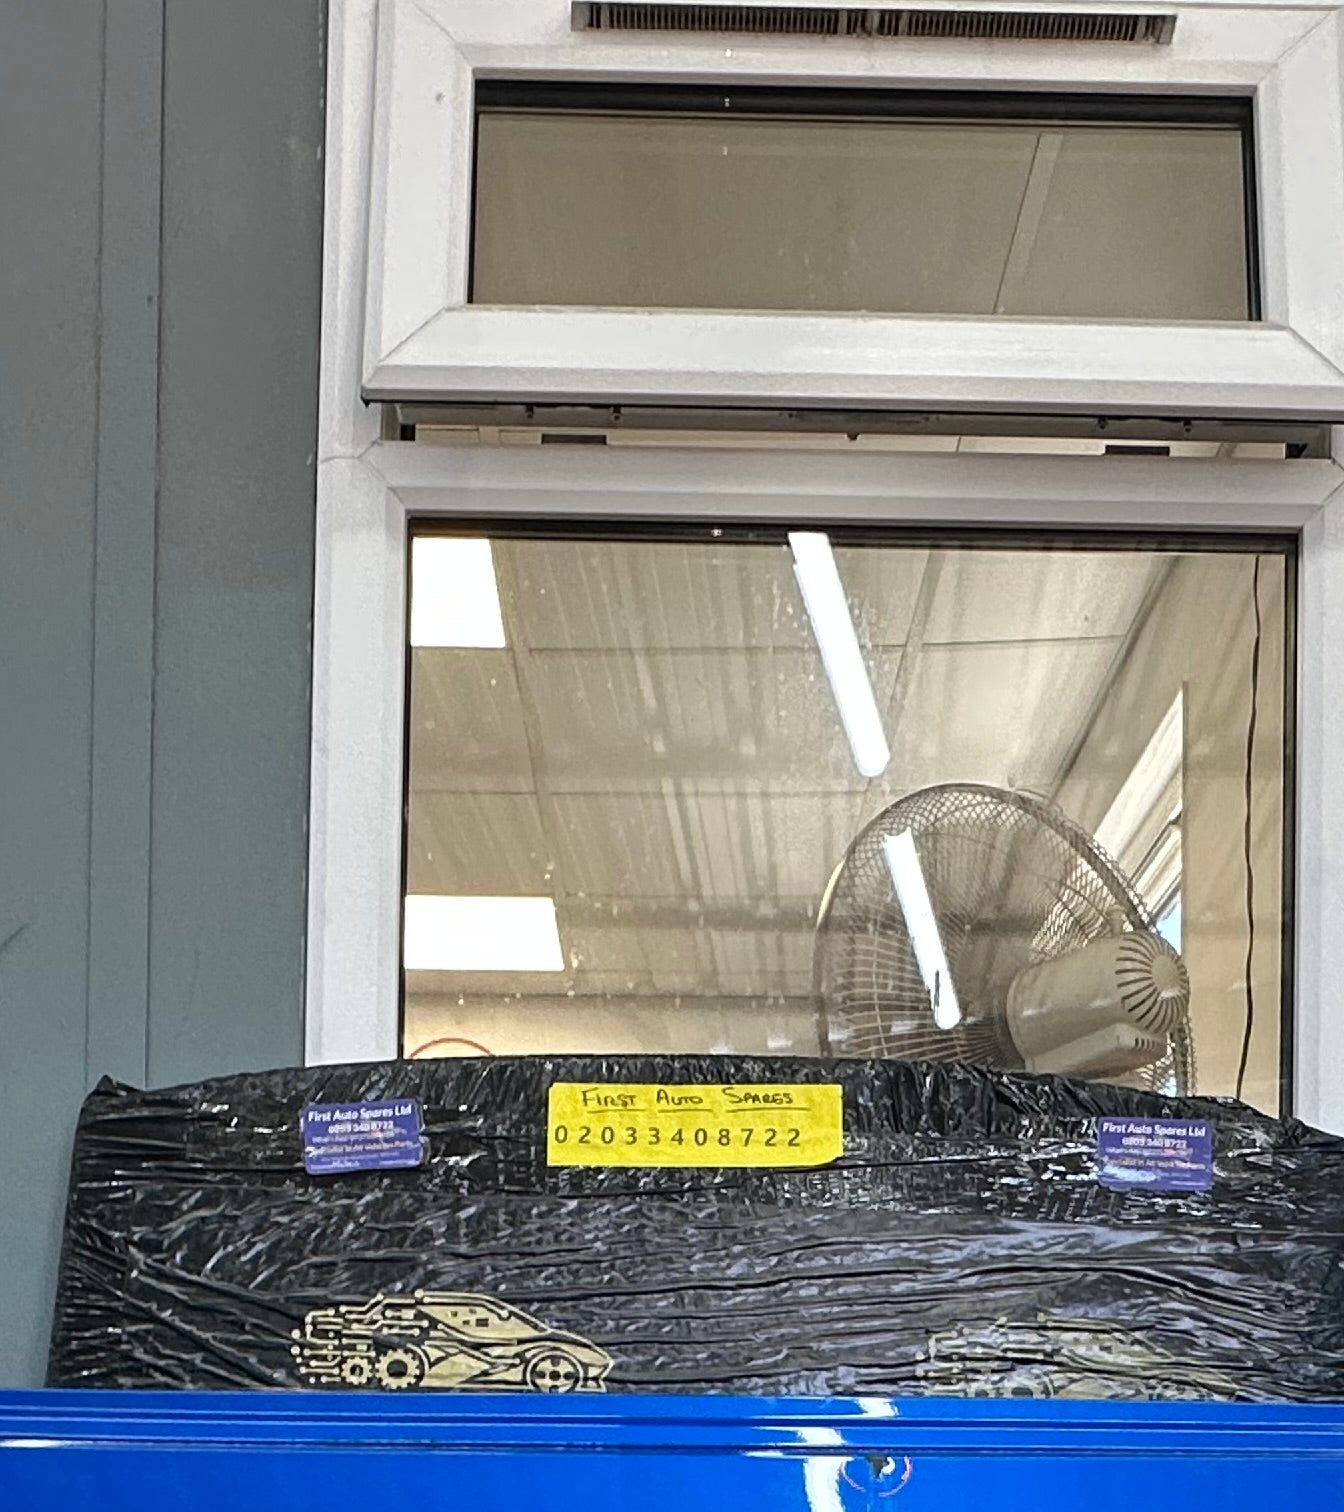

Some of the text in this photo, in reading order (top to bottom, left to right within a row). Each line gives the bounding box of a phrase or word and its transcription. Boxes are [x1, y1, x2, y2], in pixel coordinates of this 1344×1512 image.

[308, 1104, 412, 1121] First Auto Spares Ltd
[1102, 1122, 1206, 1136] First Auto Spares Ltd
